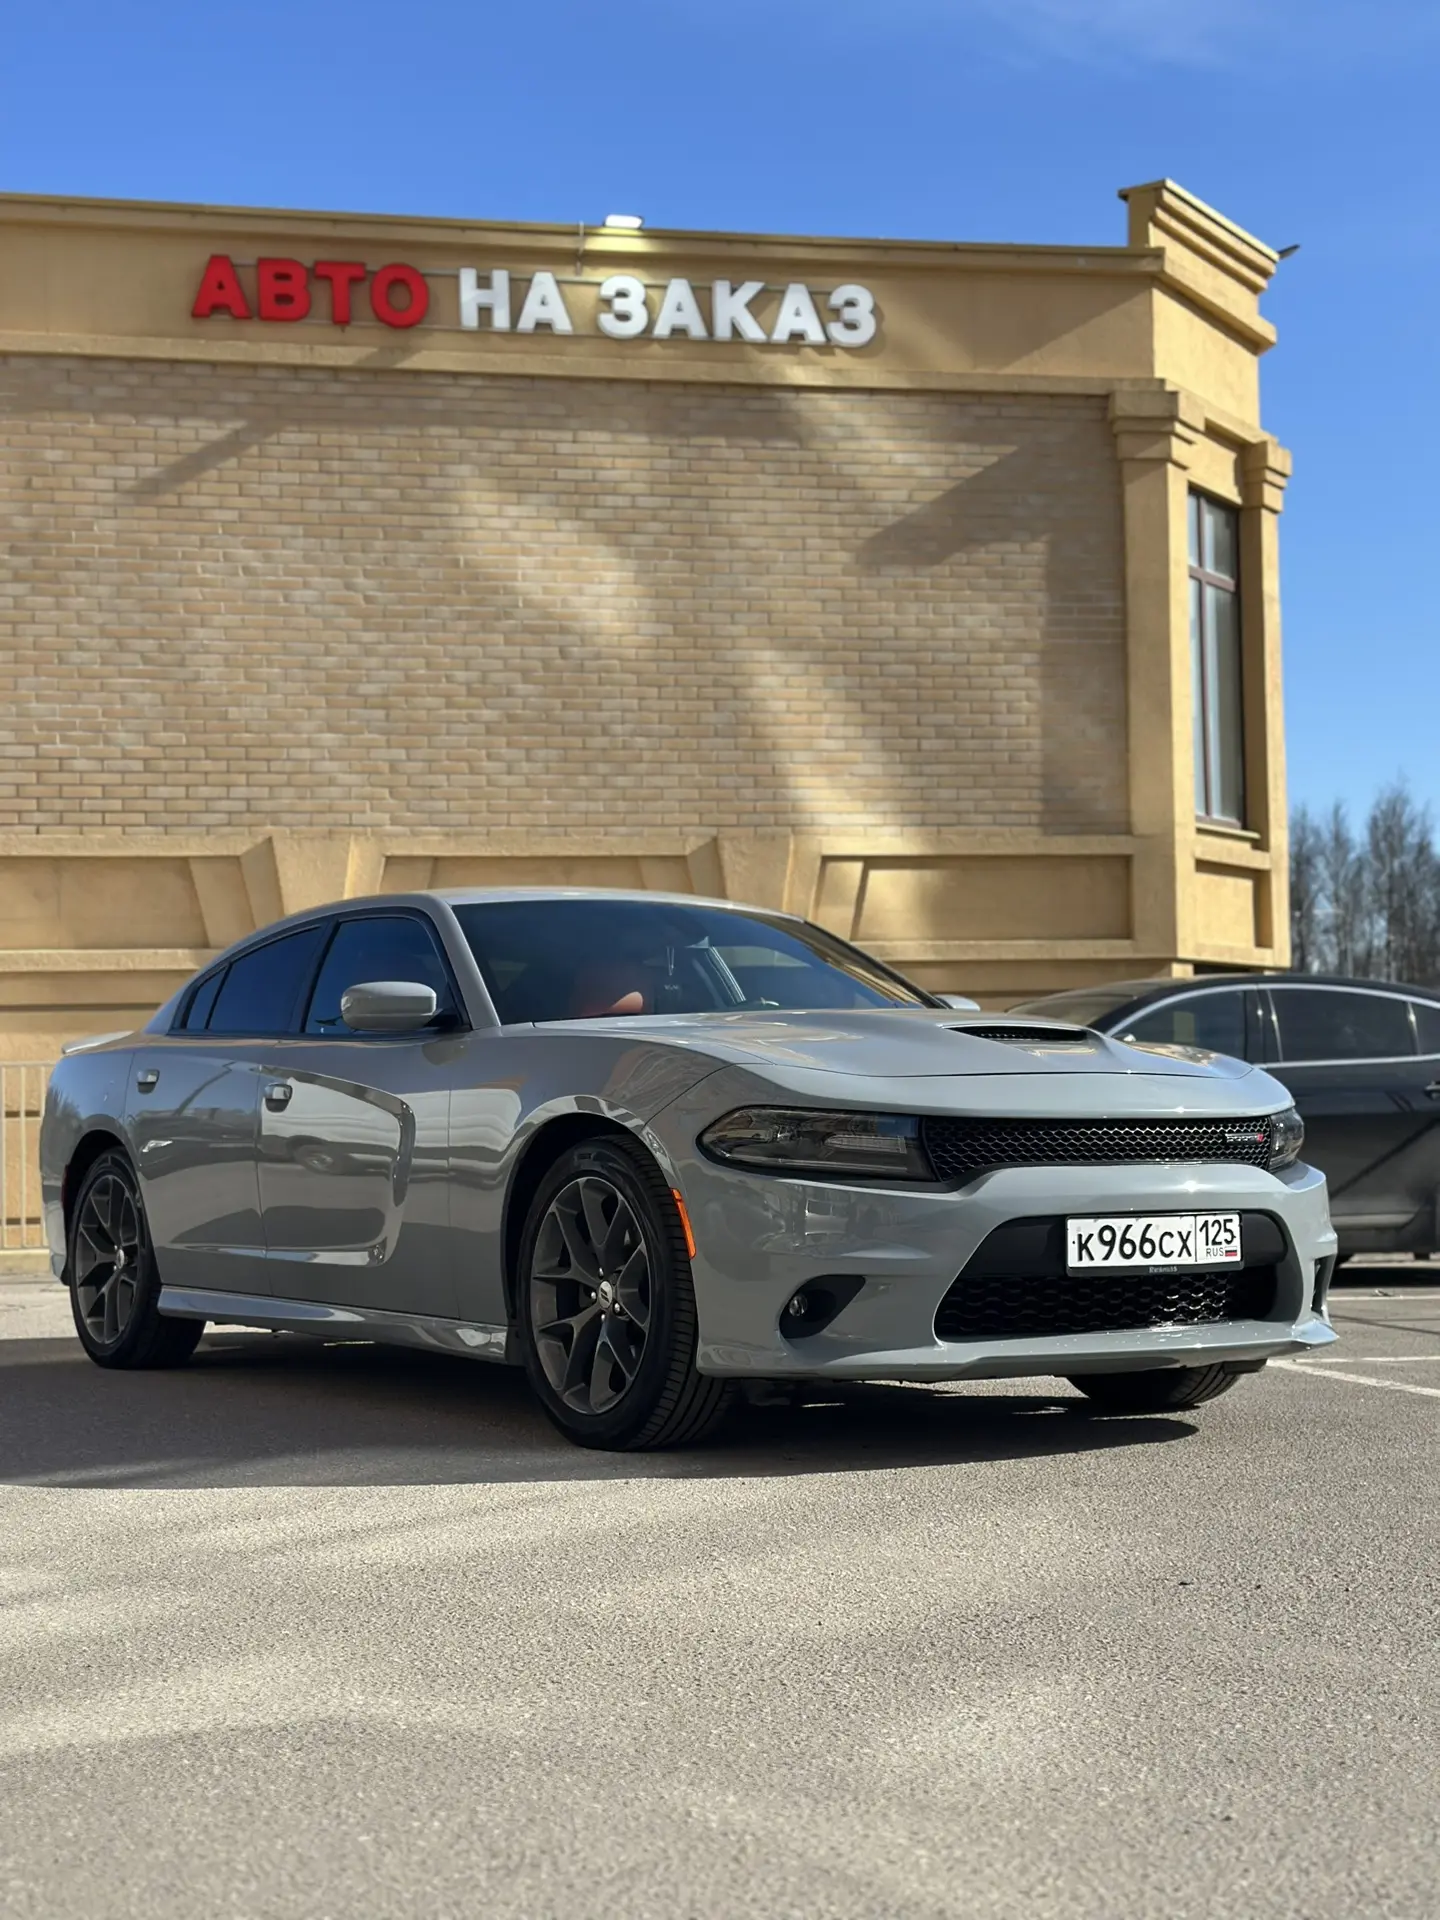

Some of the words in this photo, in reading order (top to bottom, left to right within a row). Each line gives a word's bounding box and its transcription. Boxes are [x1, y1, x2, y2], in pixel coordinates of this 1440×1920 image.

[191, 254, 430, 329] АВТО
[459, 267, 573, 334] НА
[597, 275, 876, 348] ЗАКАЗ
[1077, 1223, 1193, 1262] К966СХ
[1199, 1218, 1235, 1247] 125
[1205, 1247, 1225, 1257] RUS
